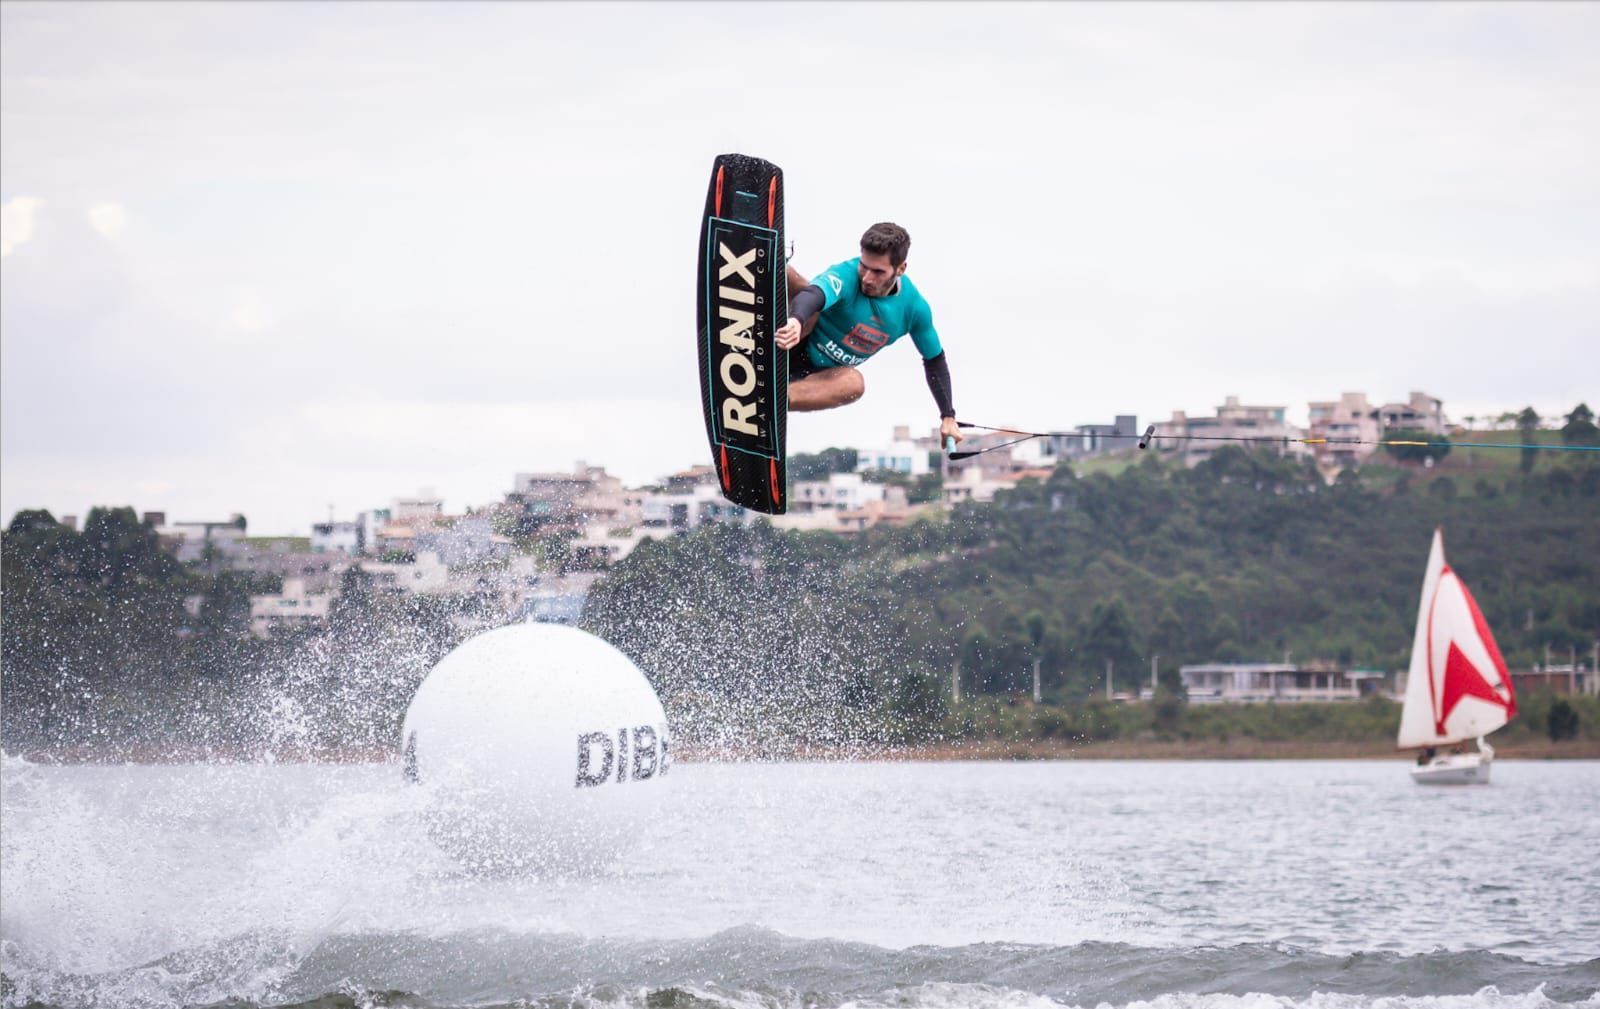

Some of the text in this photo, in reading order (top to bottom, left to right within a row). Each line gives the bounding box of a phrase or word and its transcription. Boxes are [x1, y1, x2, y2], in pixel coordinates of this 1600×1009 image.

[719, 240, 758, 437] RONIX
[756, 248, 767, 438] WAKEBOARD CO
